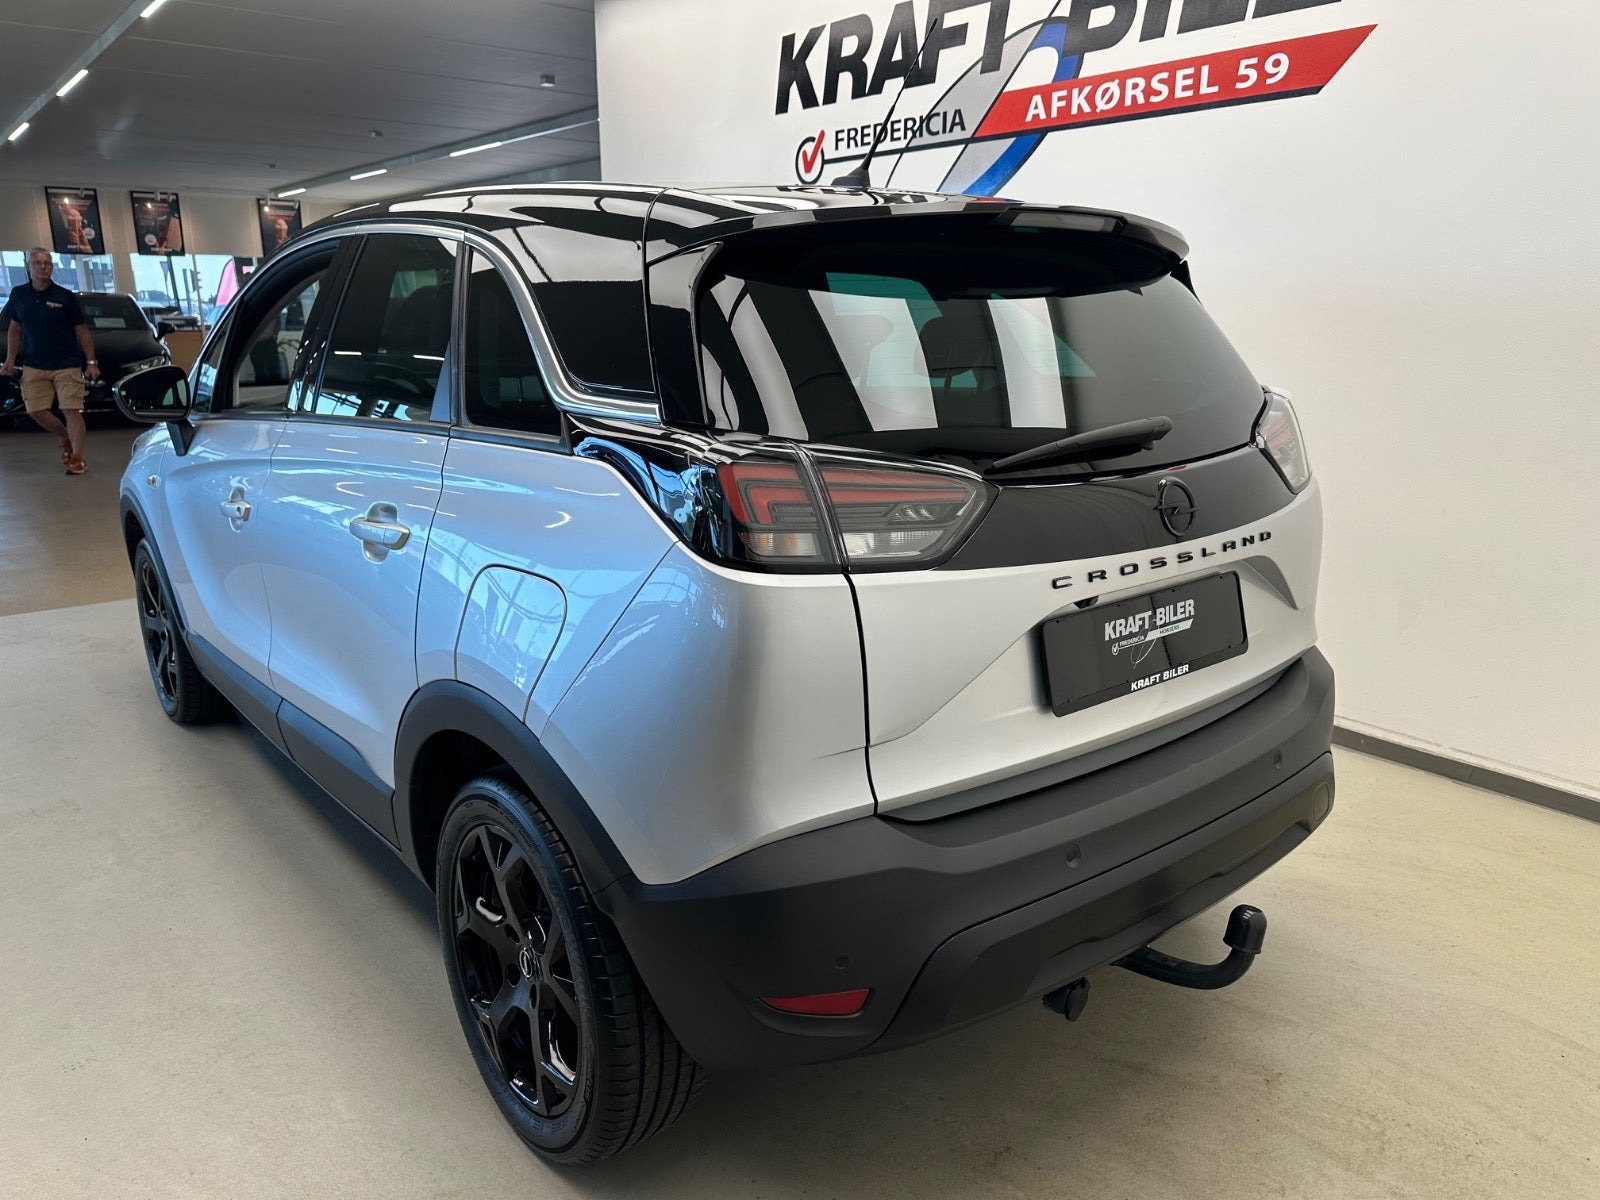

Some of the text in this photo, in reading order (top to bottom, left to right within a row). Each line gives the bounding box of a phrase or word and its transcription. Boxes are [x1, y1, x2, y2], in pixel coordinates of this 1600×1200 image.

[775, 0, 1010, 116] KRAFT
[1025, 52, 1289, 122] AFKØRSEL 59
[834, 108, 966, 151] FREDERICIA
[1051, 531, 1272, 590] CROSSLAND
[1104, 599, 1195, 641] KRAFT BILER
[1131, 664, 1189, 691] KRAFT BILER
